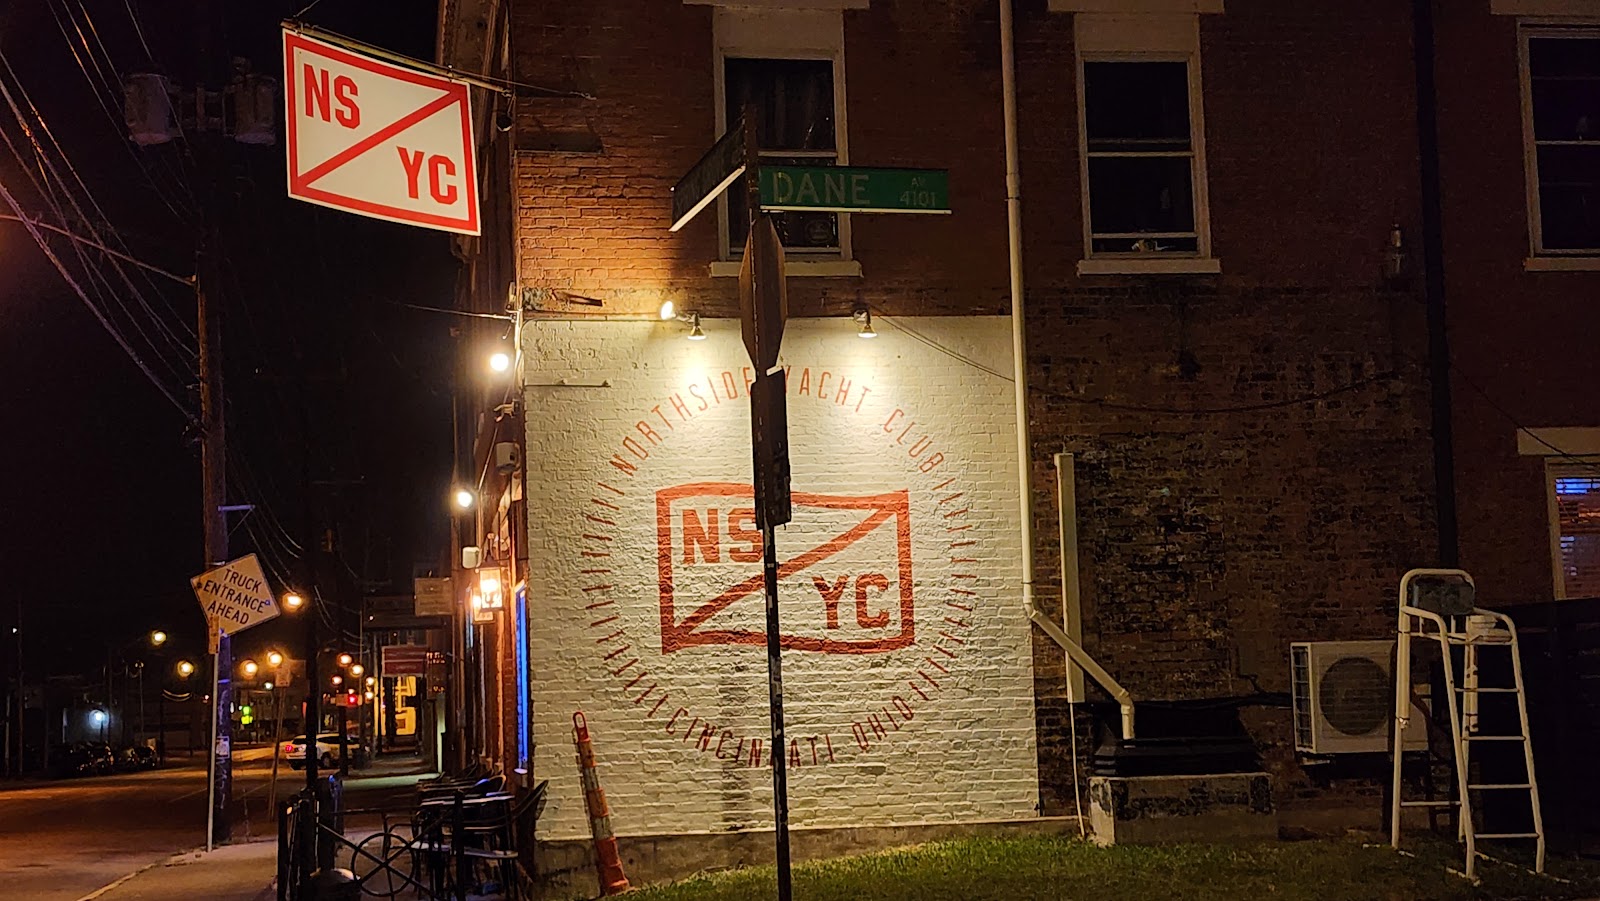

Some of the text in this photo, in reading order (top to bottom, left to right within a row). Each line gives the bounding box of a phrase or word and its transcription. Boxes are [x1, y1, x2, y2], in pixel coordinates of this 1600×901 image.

[303, 63, 360, 129] NS
[396, 146, 457, 205] YC
[773, 172, 870, 205] DANE
[900, 190, 936, 208] 4101
[609, 367, 752, 477] NORTHSIDE
[883, 408, 944, 473] CLUB
[682, 508, 764, 565] NS
[203, 580, 267, 614] ENTRANCE
[223, 568, 262, 594] TRUCK
[812, 573, 891, 630] YC
[207, 600, 250, 625] AHEAD
[665, 695, 915, 768] CINCINATI OHIO
